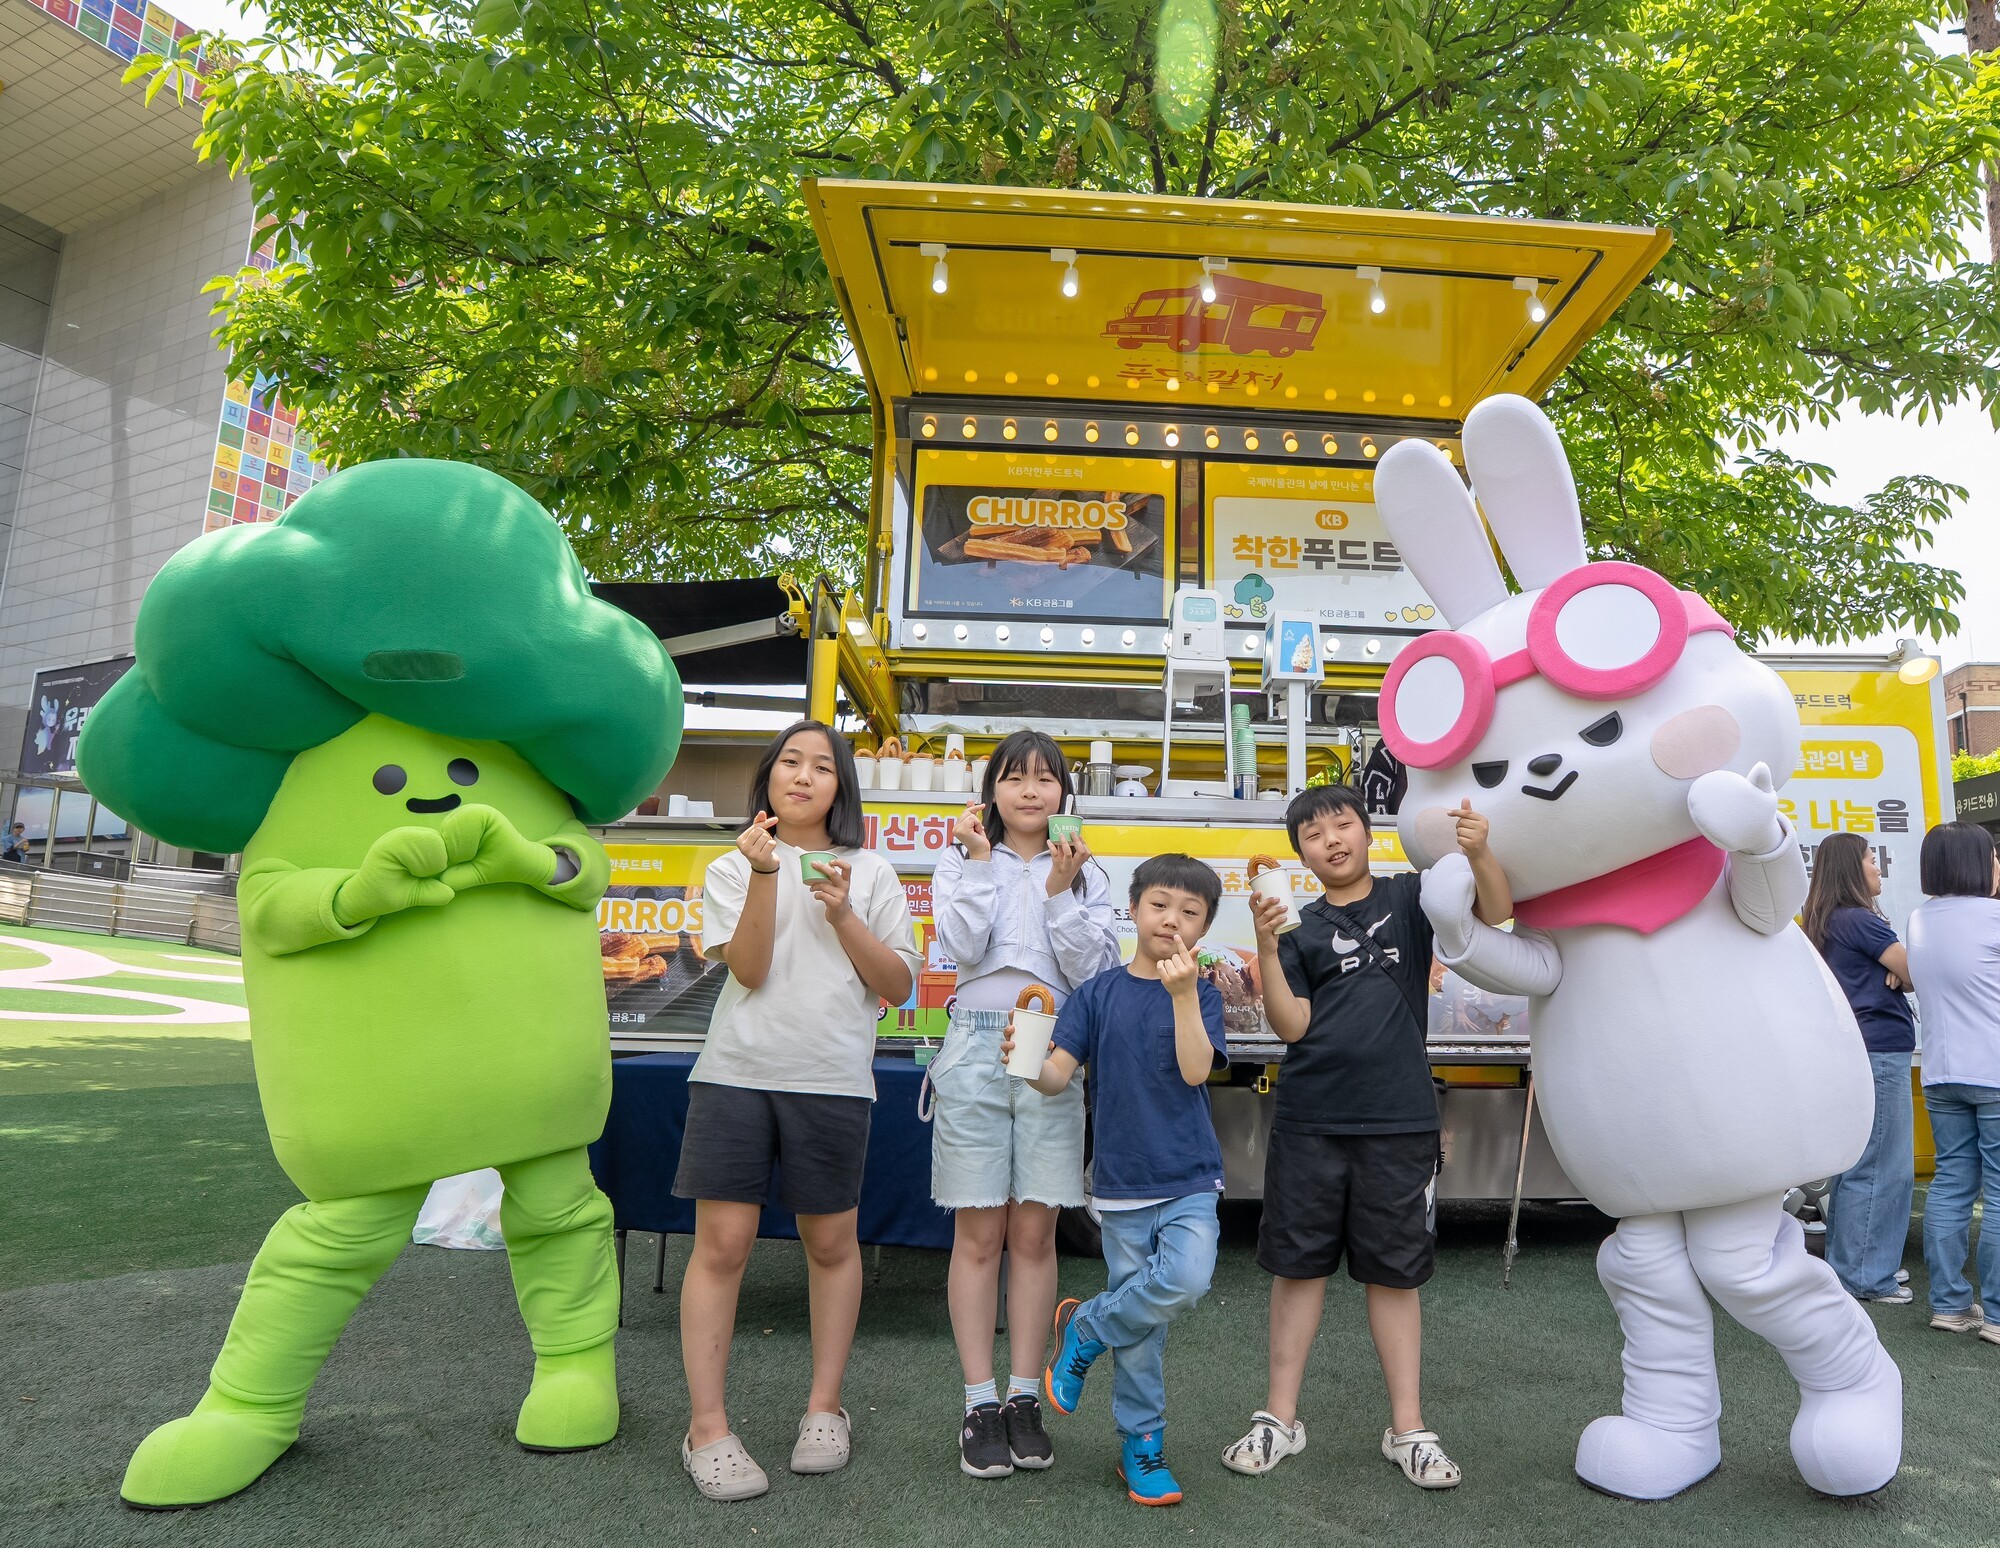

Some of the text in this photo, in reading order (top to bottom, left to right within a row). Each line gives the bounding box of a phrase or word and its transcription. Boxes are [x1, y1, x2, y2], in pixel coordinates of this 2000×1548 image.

[1008, 466, 1084, 479] KB착한푸드트럭
[967, 497, 1127, 530] CHURROS
[1321, 514, 1343, 527] KB
[1794, 694, 1852, 709] 푸드트럭
[1850, 750, 1869, 771] 날
[1956, 791, 1998, 815] 용카드전용)
[1808, 799, 1909, 833] 나눔을
[908, 900, 933, 913] 민은
[1340, 947, 1400, 974] AR
